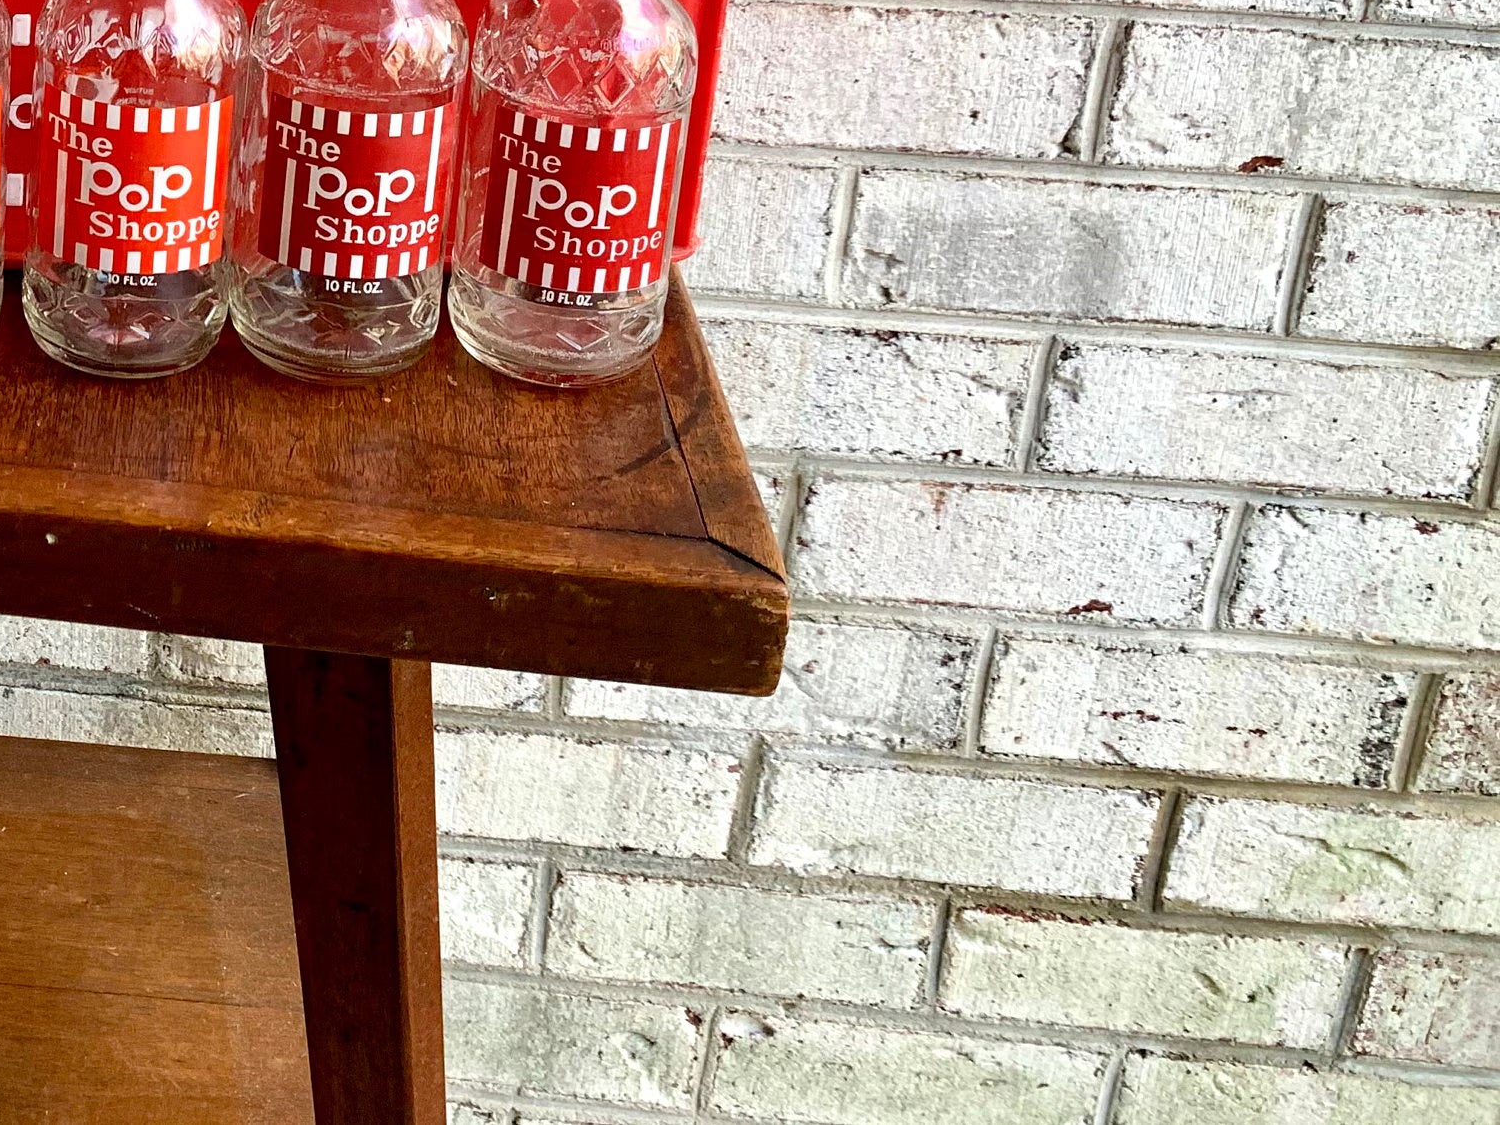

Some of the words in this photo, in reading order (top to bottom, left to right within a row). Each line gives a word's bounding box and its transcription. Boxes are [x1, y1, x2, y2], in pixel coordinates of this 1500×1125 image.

[49, 113, 113, 158] The
[276, 122, 341, 163] The
[499, 134, 562, 173] The
[89, 210, 219, 245] Shoppe
[315, 213, 440, 246] Shoppe
[533, 227, 662, 263] Shoppe
[140, 276, 158, 286] OZ.
[325, 279, 340, 292] 10
[343, 281, 362, 294] FL.
[363, 281, 383, 294] OZ.
[541, 290, 555, 303] 10
[558, 293, 574, 305] FL.
[576, 295, 593, 306] OZ.
